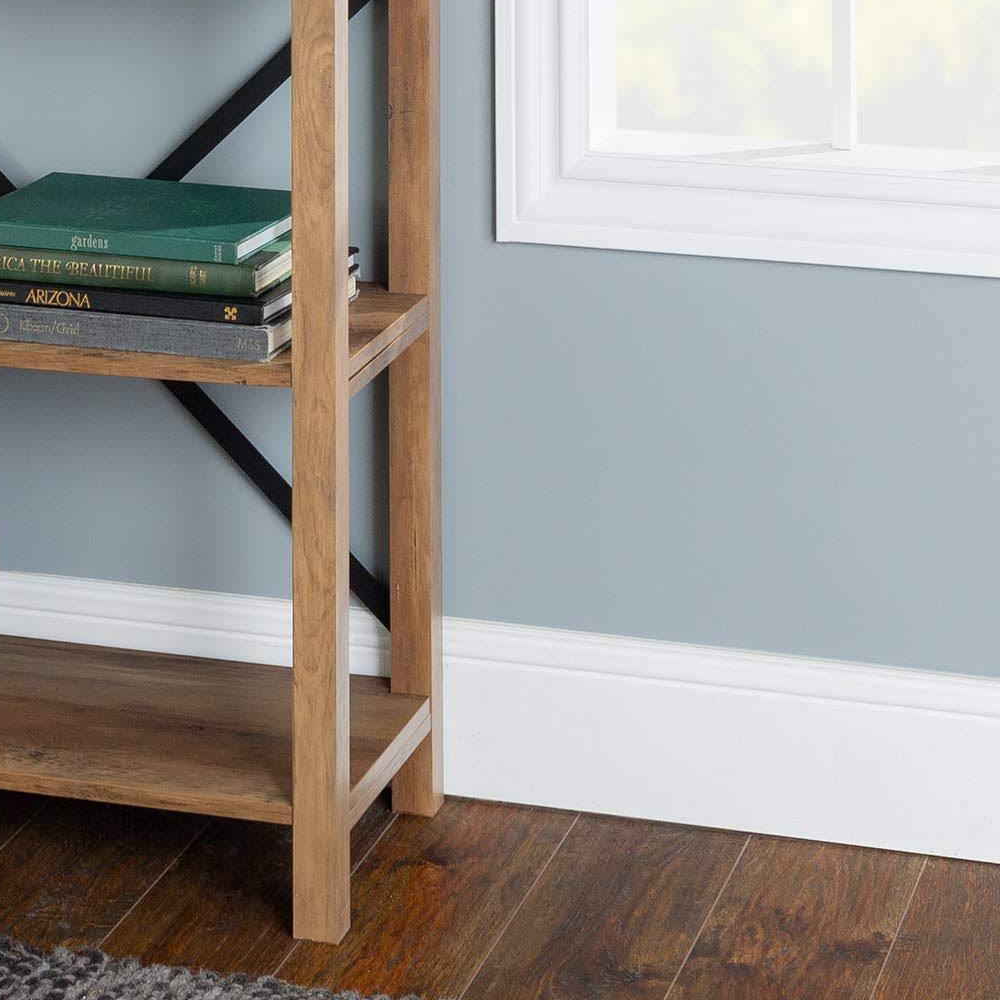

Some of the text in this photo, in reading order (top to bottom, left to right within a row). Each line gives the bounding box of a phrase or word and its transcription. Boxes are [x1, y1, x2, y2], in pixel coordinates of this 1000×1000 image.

[70, 233, 109, 251] gardens
[29, 258, 62, 274] THE
[65, 260, 153, 281] BEAUTIFUL
[25, 288, 91, 308] ARIZONA
